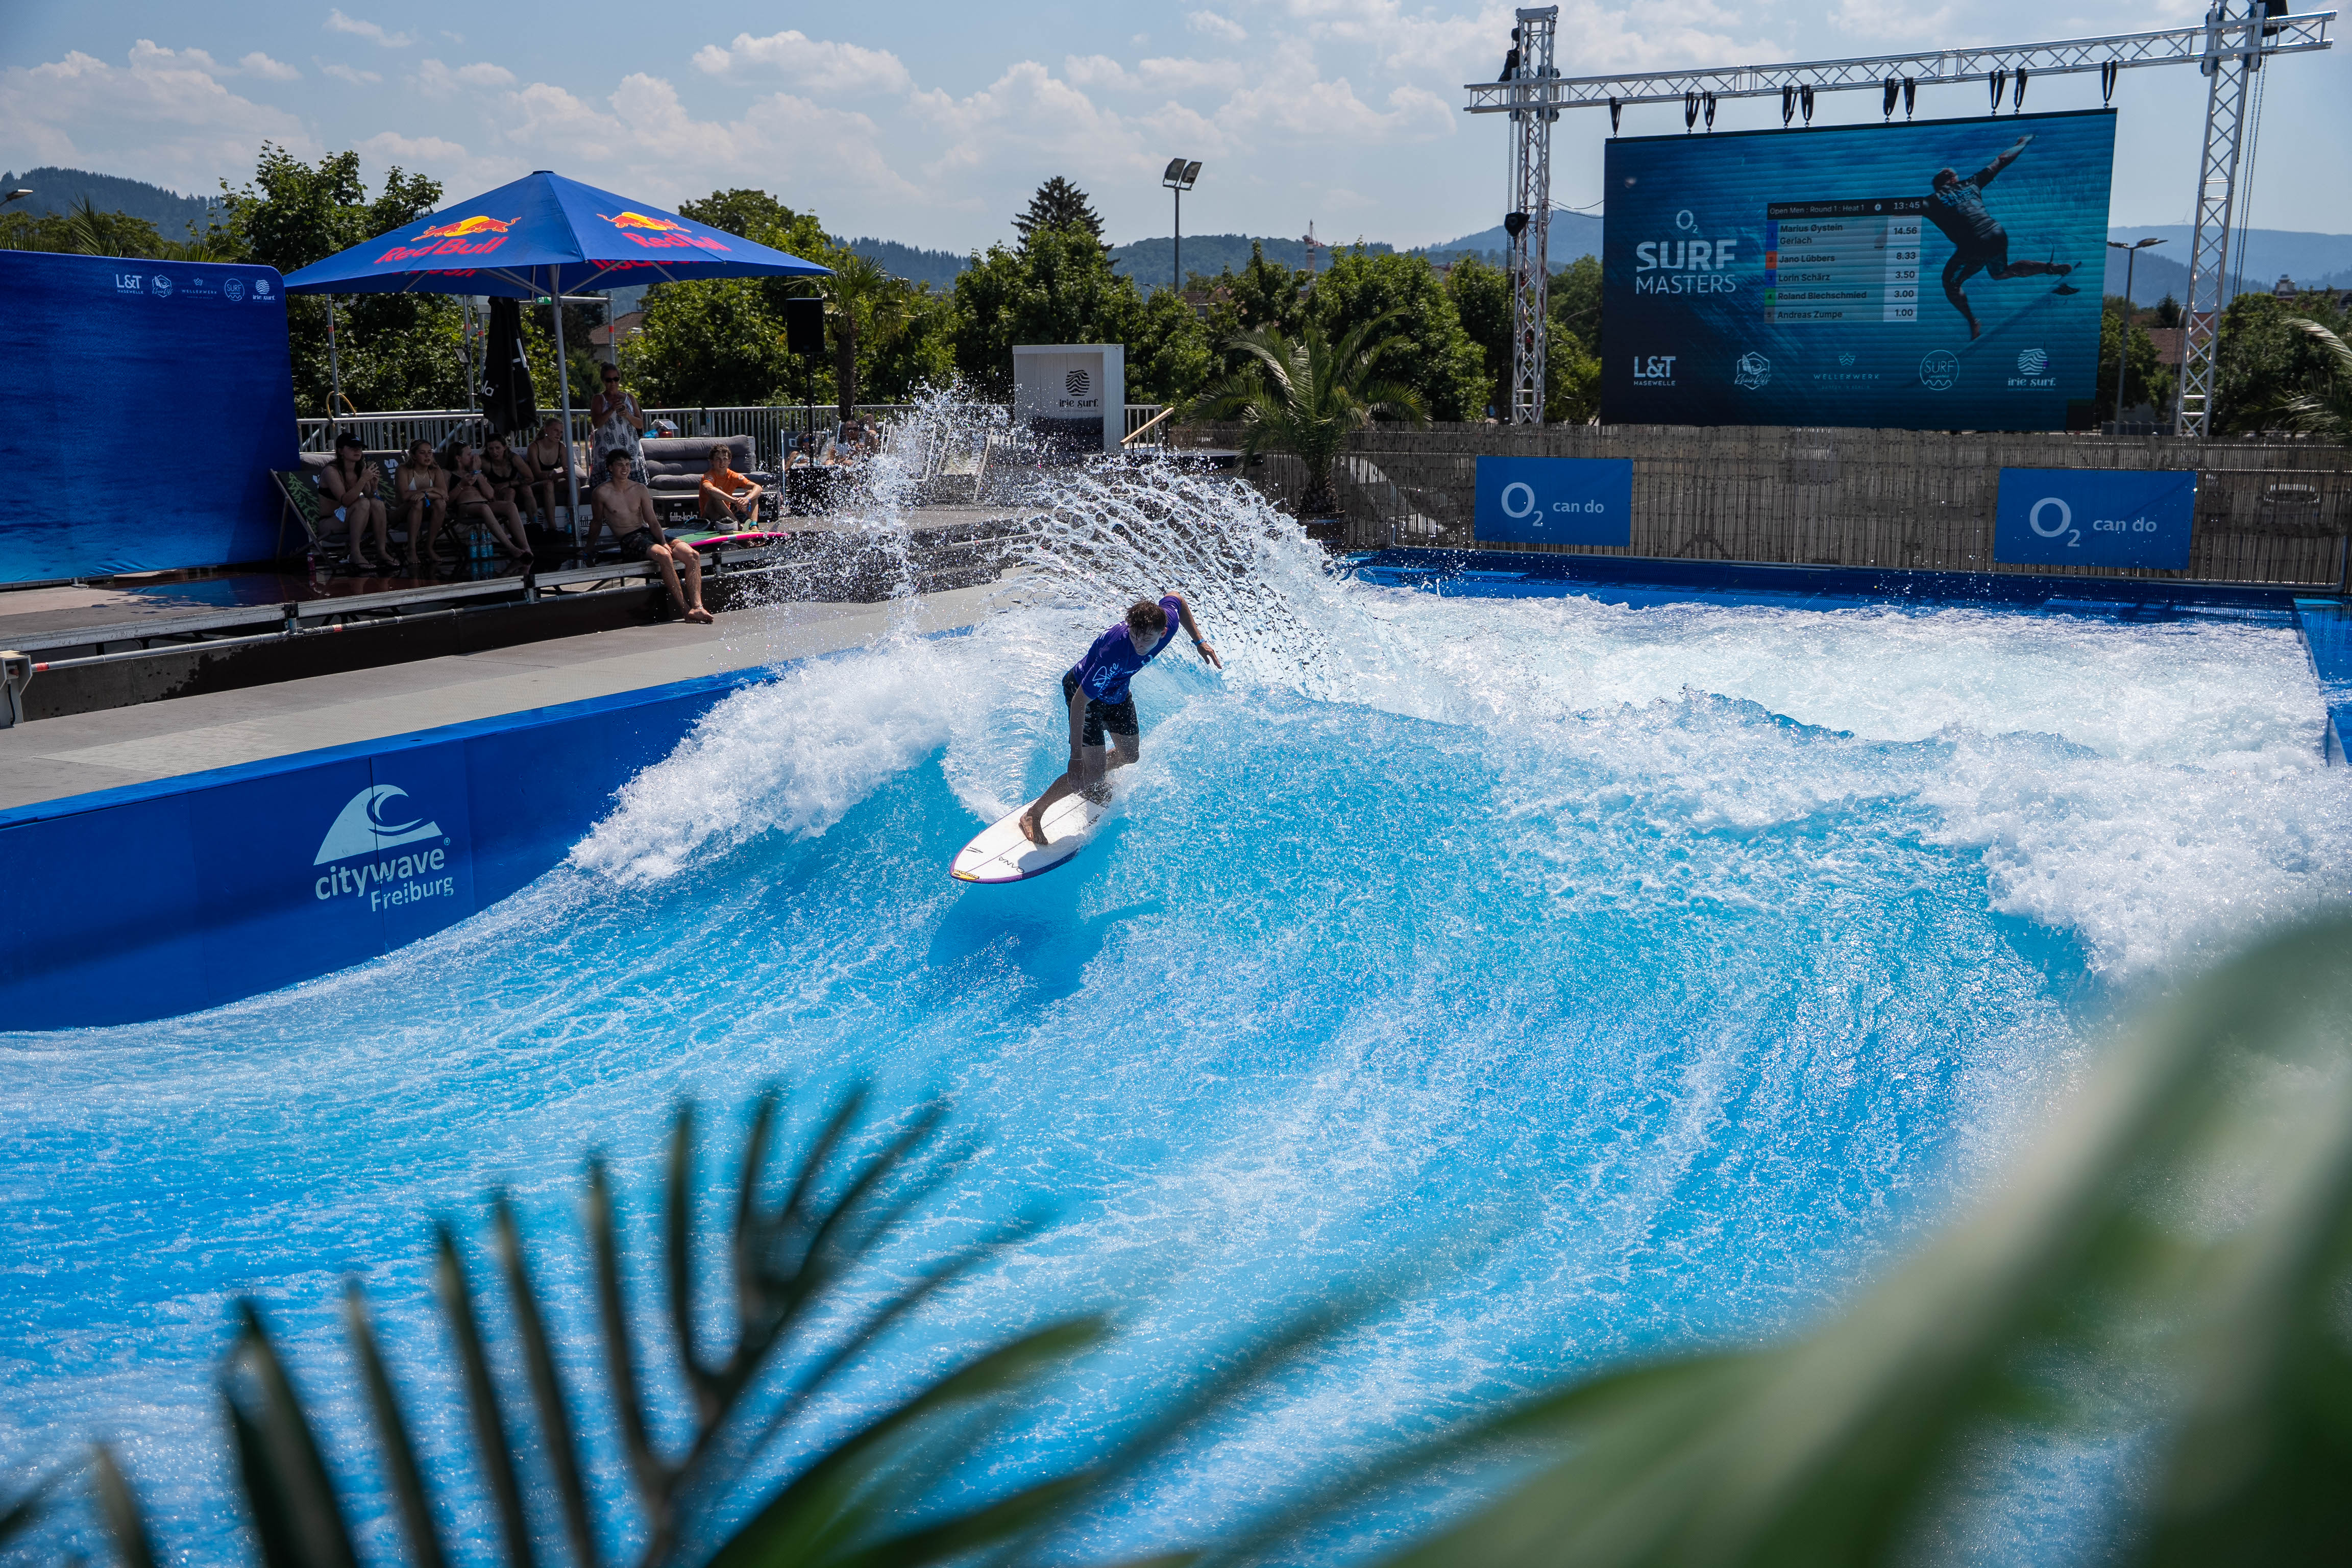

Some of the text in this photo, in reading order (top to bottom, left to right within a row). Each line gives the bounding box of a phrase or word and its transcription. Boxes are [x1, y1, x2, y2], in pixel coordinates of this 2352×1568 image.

[1894, 202, 1920, 210] 13:45
[1780, 224, 1843, 233] Marius Øystein
[1894, 227, 1918, 235] 14.56
[622, 232, 732, 252] Red Bull
[1780, 236, 1812, 244] Gerlach
[374, 236, 509, 264] Red Bull
[1636, 239, 1737, 273] SURF
[1779, 254, 1835, 263] Jano Lübbers
[1896, 252, 1916, 260] 8.33
[1778, 273, 1830, 282] Lorin Schärz
[1895, 271, 1915, 279] 3.50
[115, 274, 142, 289] L&T
[1636, 274, 1736, 295] MASTERS
[227, 284, 242, 292] SURF
[1778, 290, 1867, 300] Roland Blechschmied
[1894, 290, 1915, 298] 3.00
[1777, 310, 1843, 320] Andreas Zumpe
[1894, 309, 1914, 317] 1.00
[1633, 355, 1676, 378] L&T
[1924, 360, 1955, 374] SURF
[2007, 377, 2056, 387] irie surf.
[1059, 399, 1099, 408] irie surf.
[1501, 482, 1604, 527] O2 can do
[2029, 497, 2157, 547] O2 can do
[315, 848, 445, 900] citywave
[371, 876, 454, 912] Freiburg
